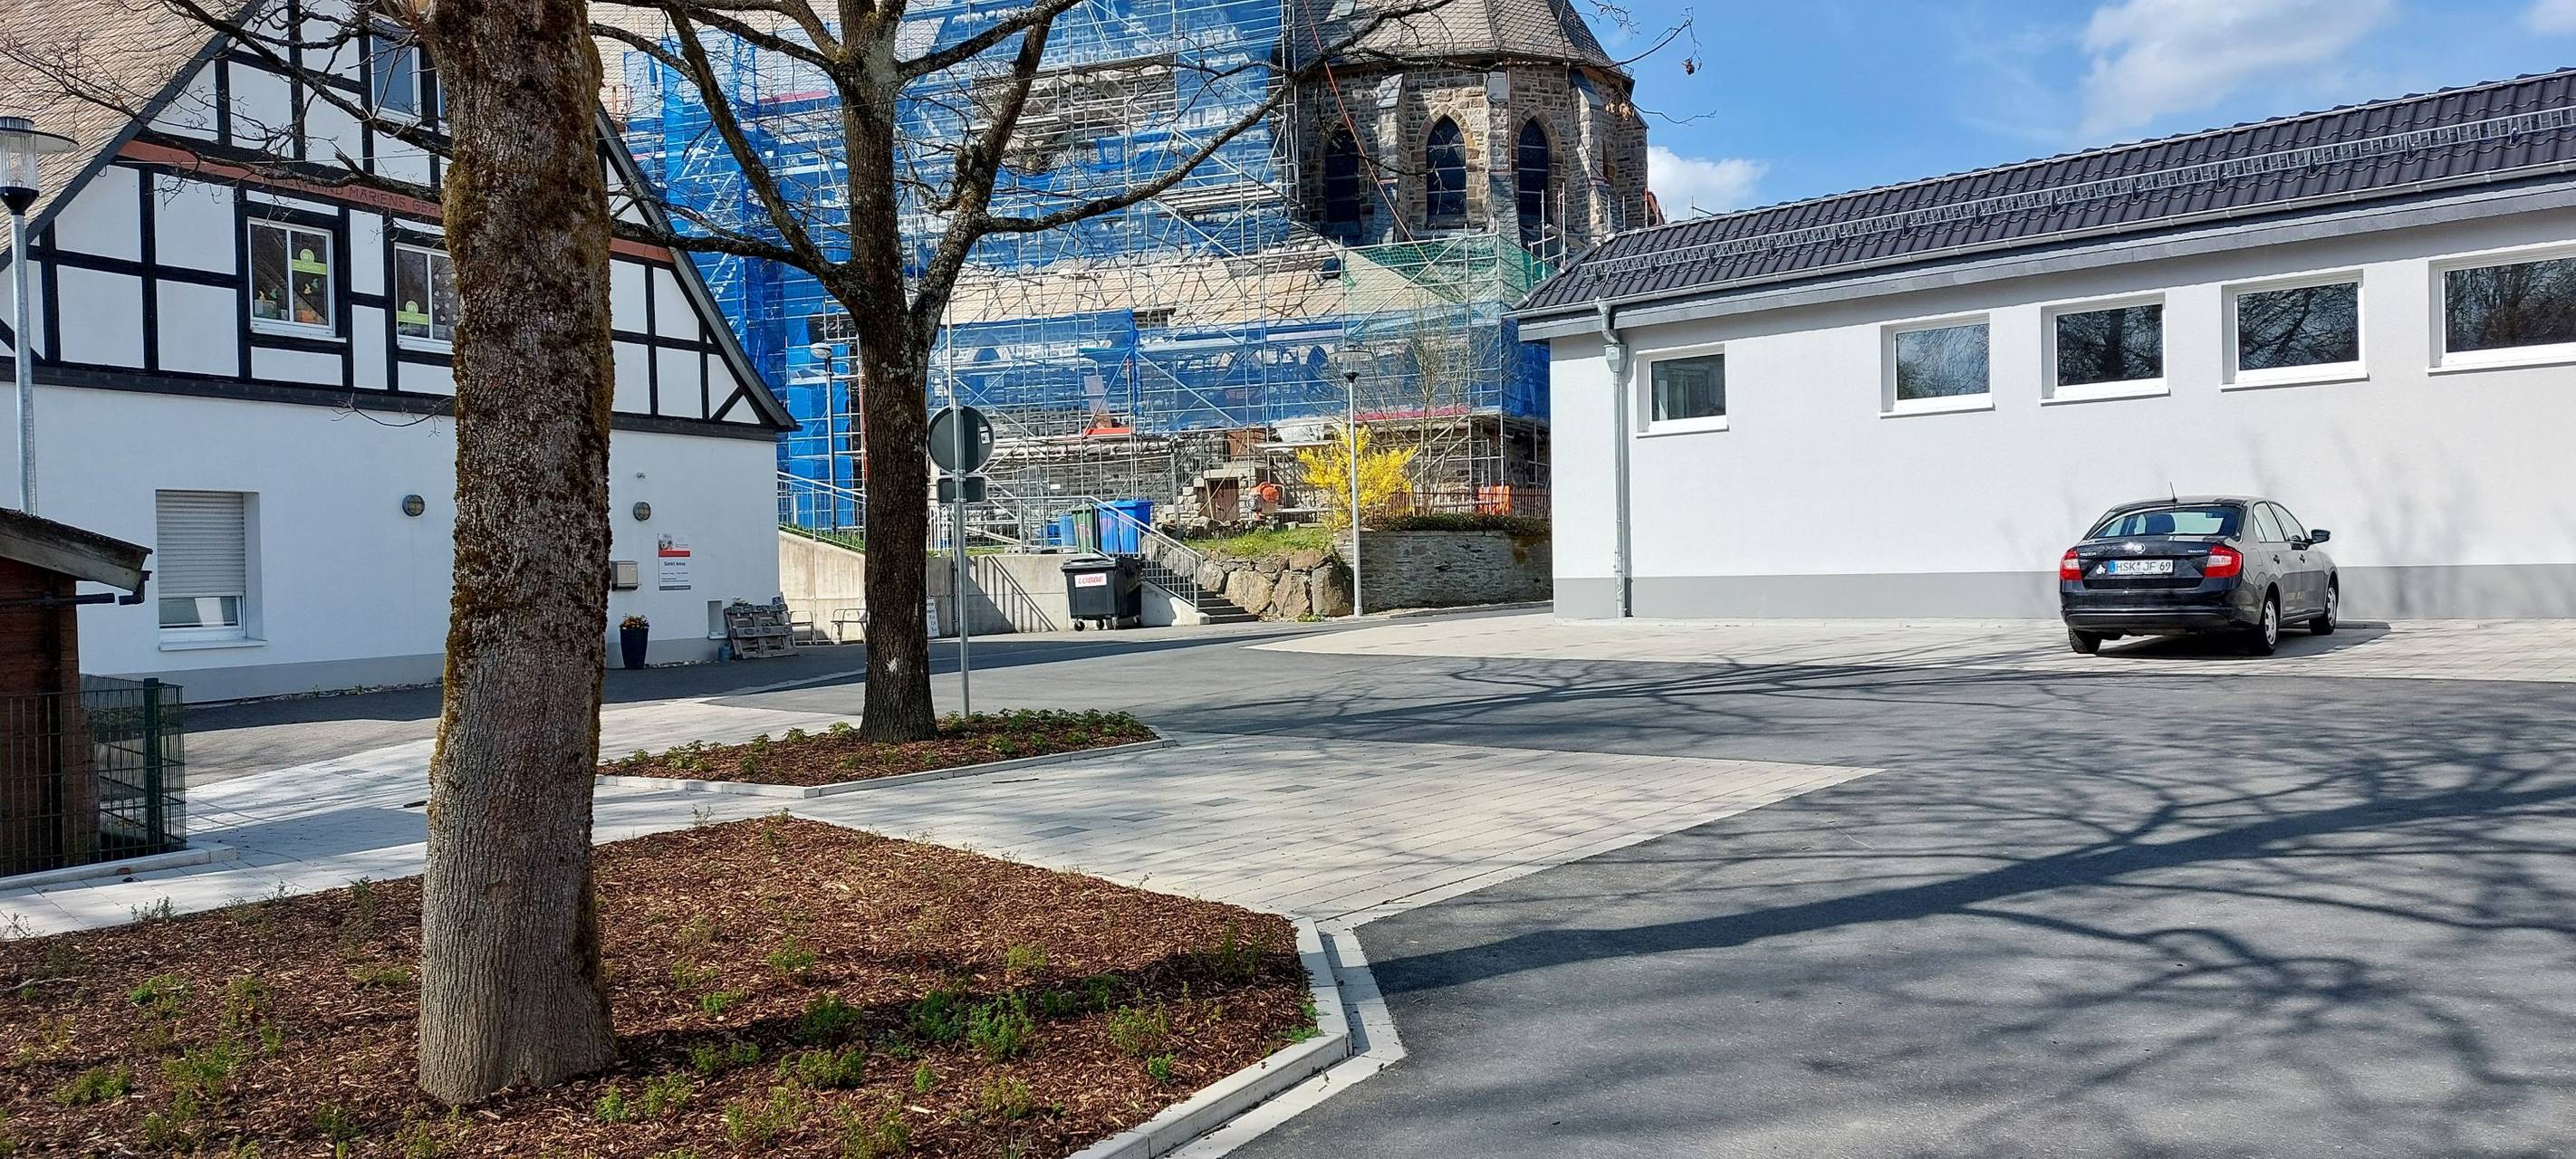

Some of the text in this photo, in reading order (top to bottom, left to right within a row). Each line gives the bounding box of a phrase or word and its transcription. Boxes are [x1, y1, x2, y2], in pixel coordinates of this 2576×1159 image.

[349, 187, 406, 208] MARIENS
[411, 199, 440, 214] GEH
[2116, 561, 2171, 571] HSK JF 69
